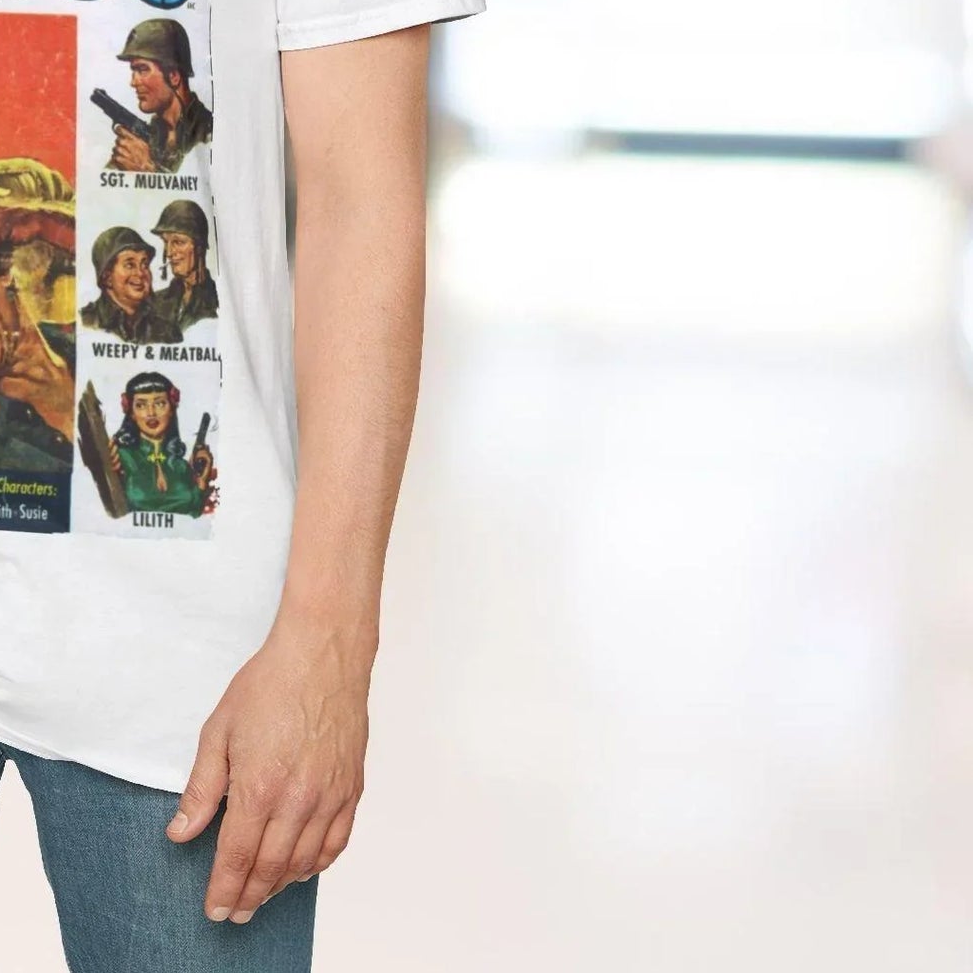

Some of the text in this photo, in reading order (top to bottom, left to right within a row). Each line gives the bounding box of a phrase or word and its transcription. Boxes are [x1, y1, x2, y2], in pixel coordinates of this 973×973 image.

[100, 172, 198, 191] SGT. MULVANEY
[92, 342, 139, 359] WEEPY
[145, 344, 155, 360] &
[19, 503, 48, 520] Susie
[133, 512, 174, 528] LILITH
